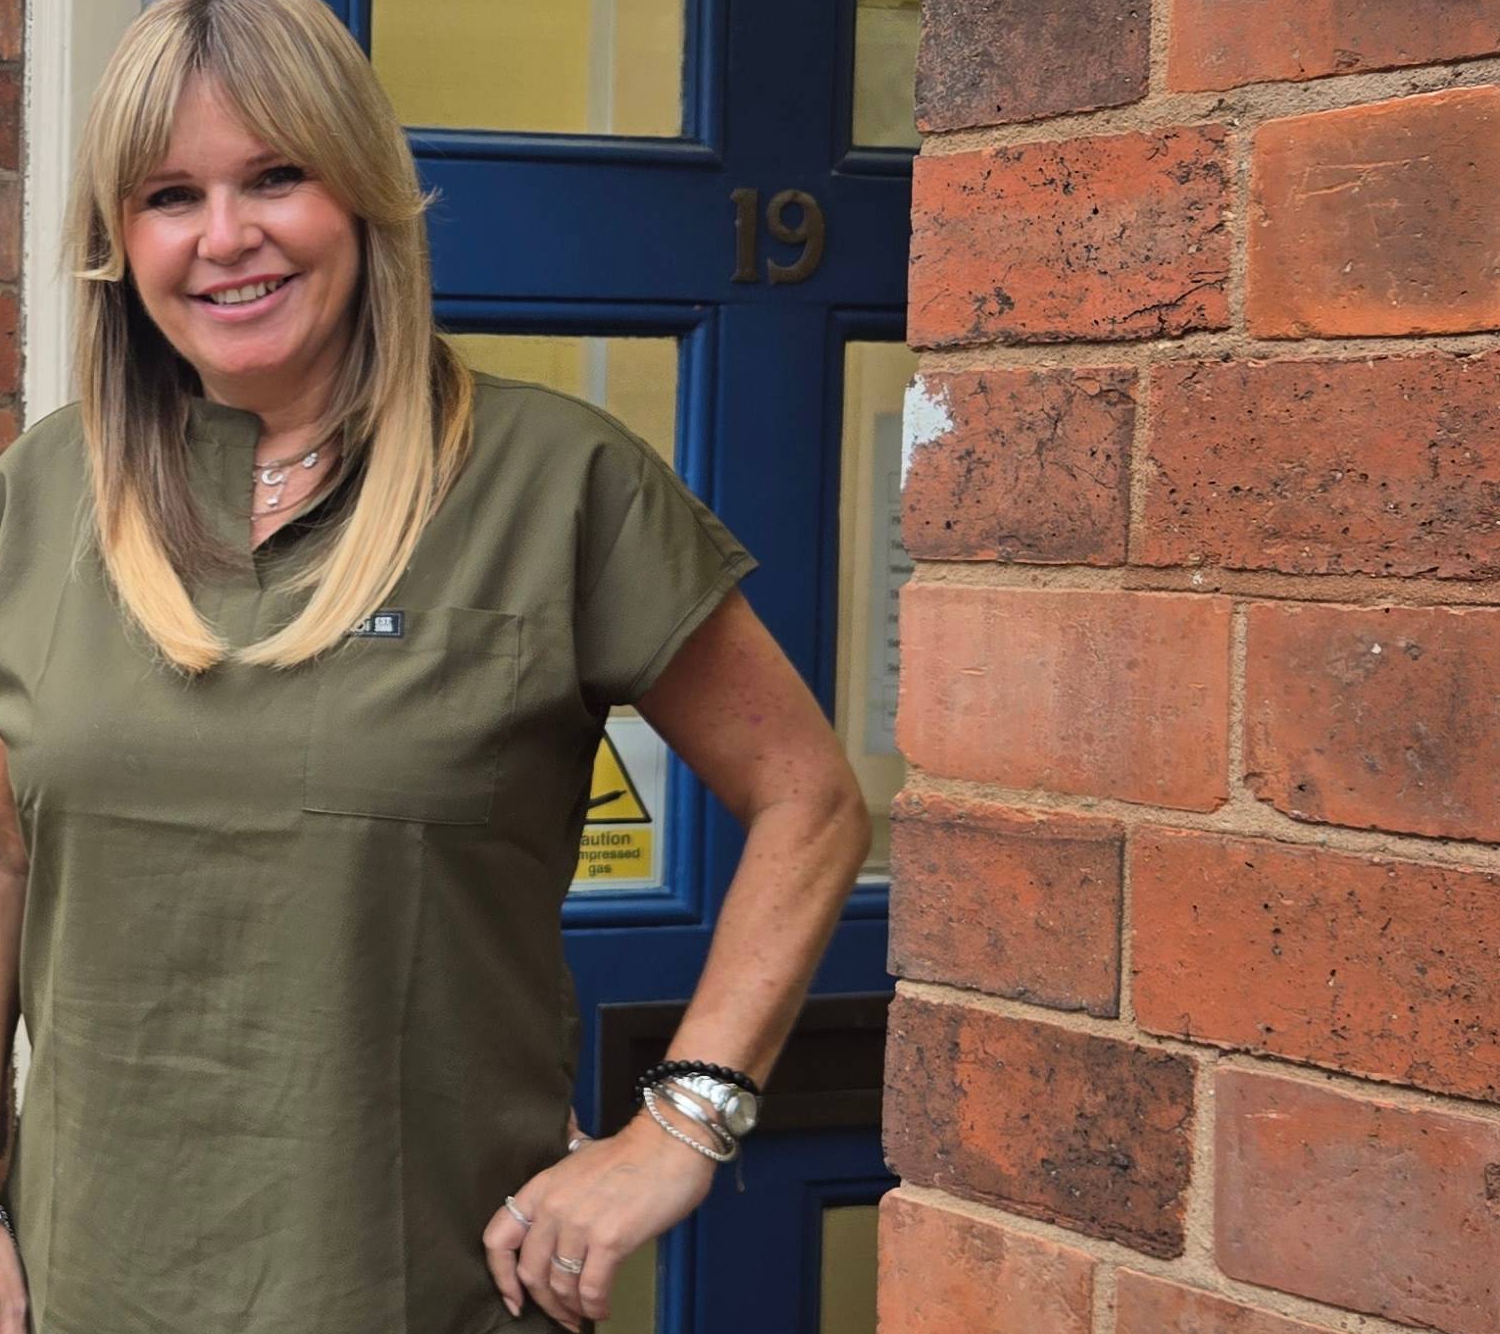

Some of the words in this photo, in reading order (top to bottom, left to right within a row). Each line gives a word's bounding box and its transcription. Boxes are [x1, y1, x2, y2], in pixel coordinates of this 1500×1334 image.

[730, 187, 825, 286] 19
[580, 831, 631, 846] aution
[588, 864, 612, 877] gas
